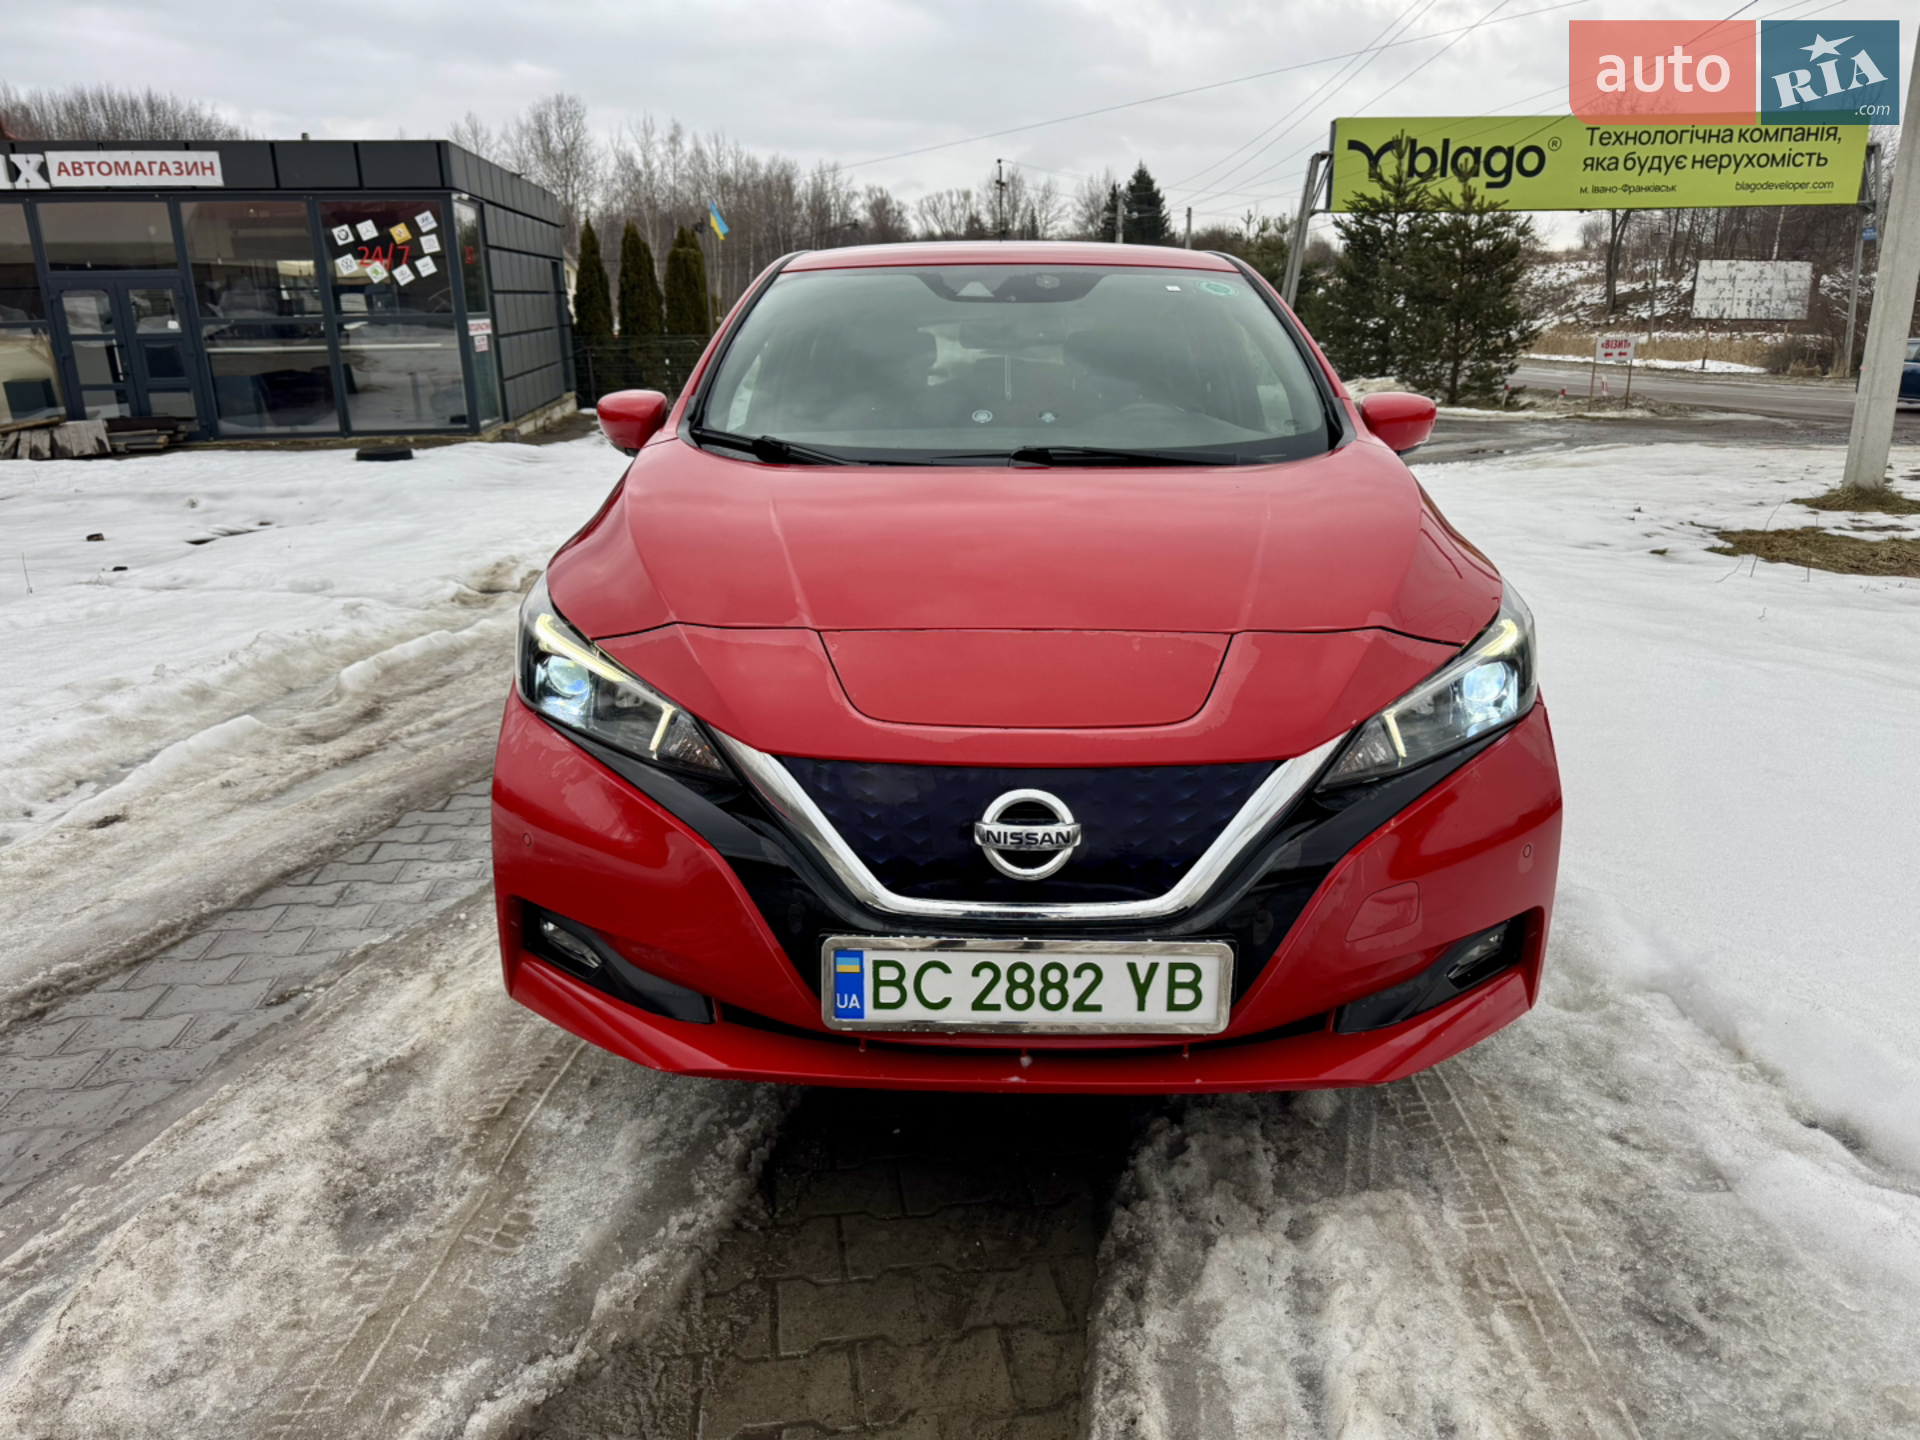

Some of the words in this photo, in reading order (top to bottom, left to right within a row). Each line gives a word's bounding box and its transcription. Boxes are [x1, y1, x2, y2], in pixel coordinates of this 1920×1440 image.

[1585, 125, 1734, 147] Технологічна
[1738, 123, 1842, 145] компанія,
[57, 161, 216, 176] АВТОМАГАЗИН
[1582, 155, 1620, 172] яка
[1623, 151, 1688, 176] будує
[1691, 148, 1829, 175] нерухомість
[1592, 182, 1677, 195] Івано-Франківськ
[1735, 180, 1834, 193] blagodeveloper.com
[357, 243, 412, 270] 24/7
[985, 829, 1071, 846] NISSAN
[872, 959, 952, 1010] BC
[971, 961, 1103, 1011] 2882
[1127, 962, 1203, 1011] YB
[836, 993, 861, 1009] UA
